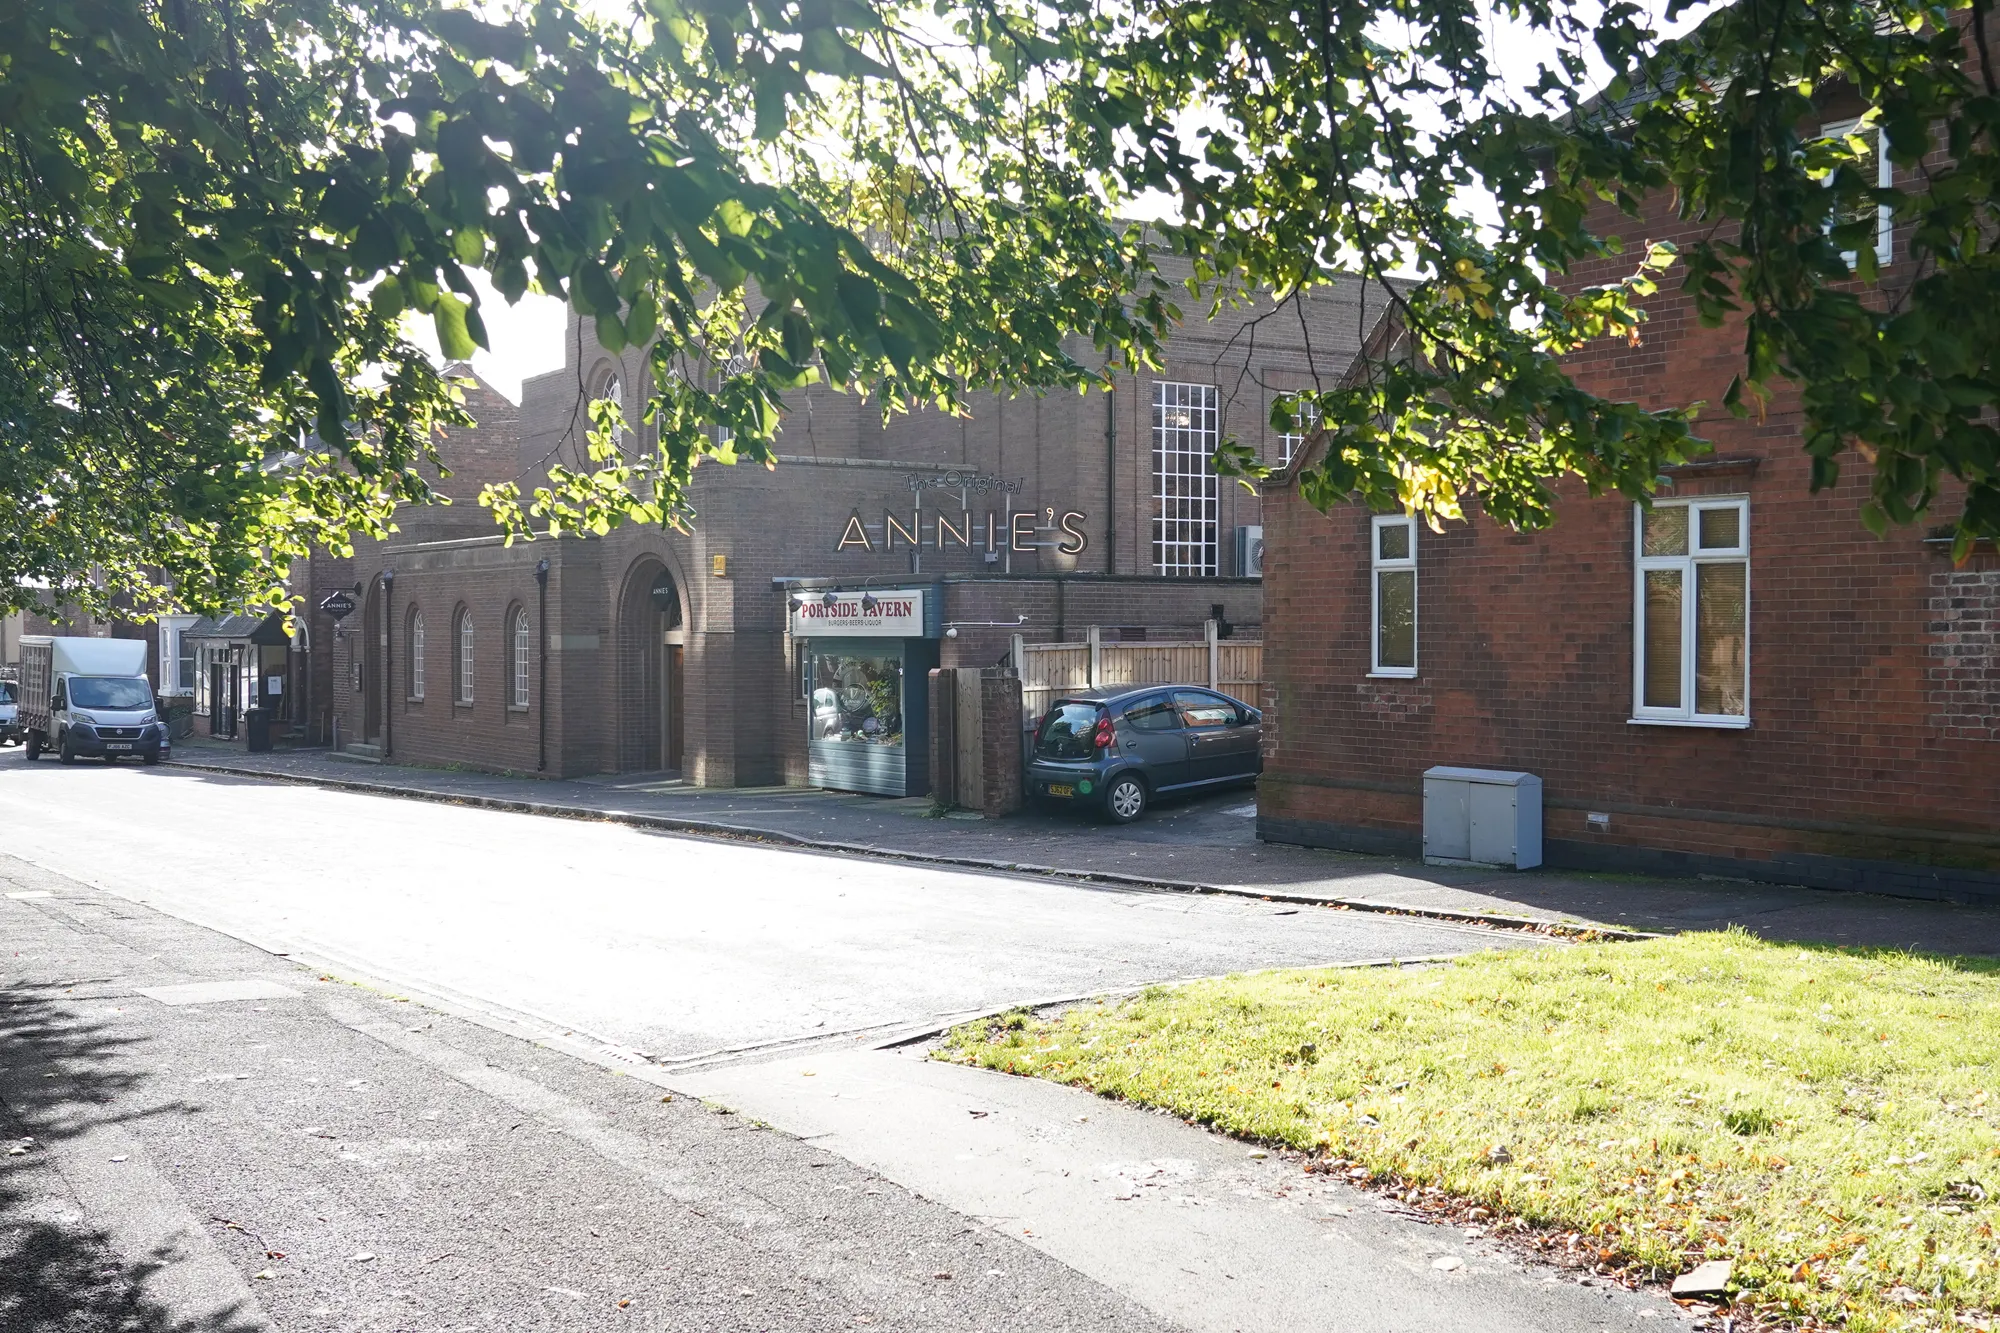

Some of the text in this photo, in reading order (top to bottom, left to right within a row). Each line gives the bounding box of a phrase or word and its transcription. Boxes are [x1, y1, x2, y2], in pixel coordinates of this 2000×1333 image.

[902, 469, 1024, 495] The Original
[834, 506, 1088, 555] ANNIE'S
